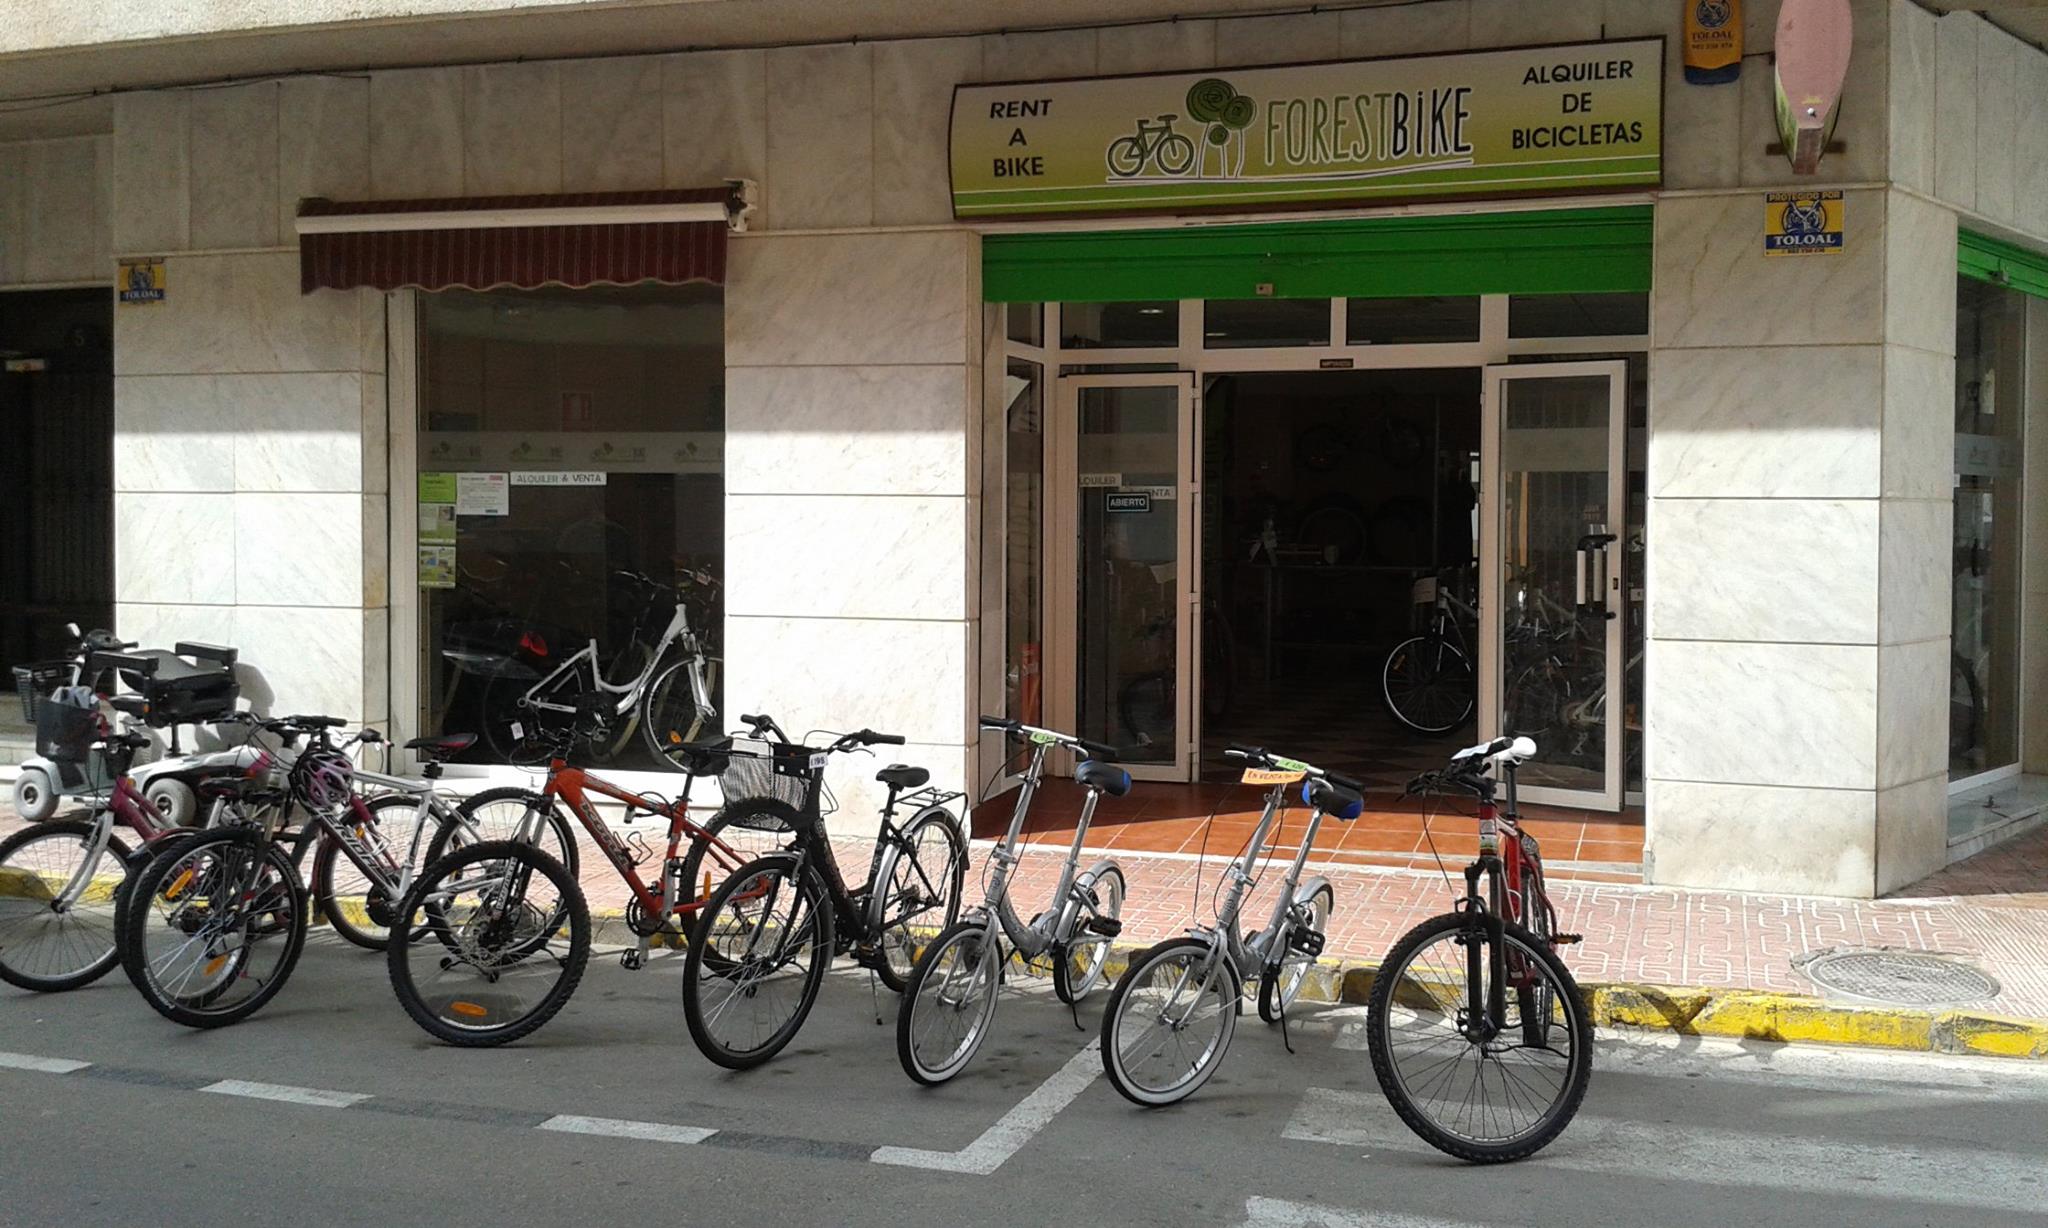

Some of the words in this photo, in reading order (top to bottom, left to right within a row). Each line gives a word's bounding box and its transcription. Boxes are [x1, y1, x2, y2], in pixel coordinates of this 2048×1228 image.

[1522, 60, 1634, 86] ALQUILER
[990, 99, 1053, 119] RENT
[1562, 92, 1592, 113] DE
[1008, 127, 1027, 147] A
[1512, 121, 1643, 149] BICICLETAS
[993, 156, 1045, 178] BIKE
[1773, 234, 1836, 246] TOLOAL
[517, 474, 559, 484] ALQUILER
[572, 473, 602, 483] VENTA
[1079, 475, 1117, 485] LQUILER
[1110, 498, 1146, 507] ABIERTO
